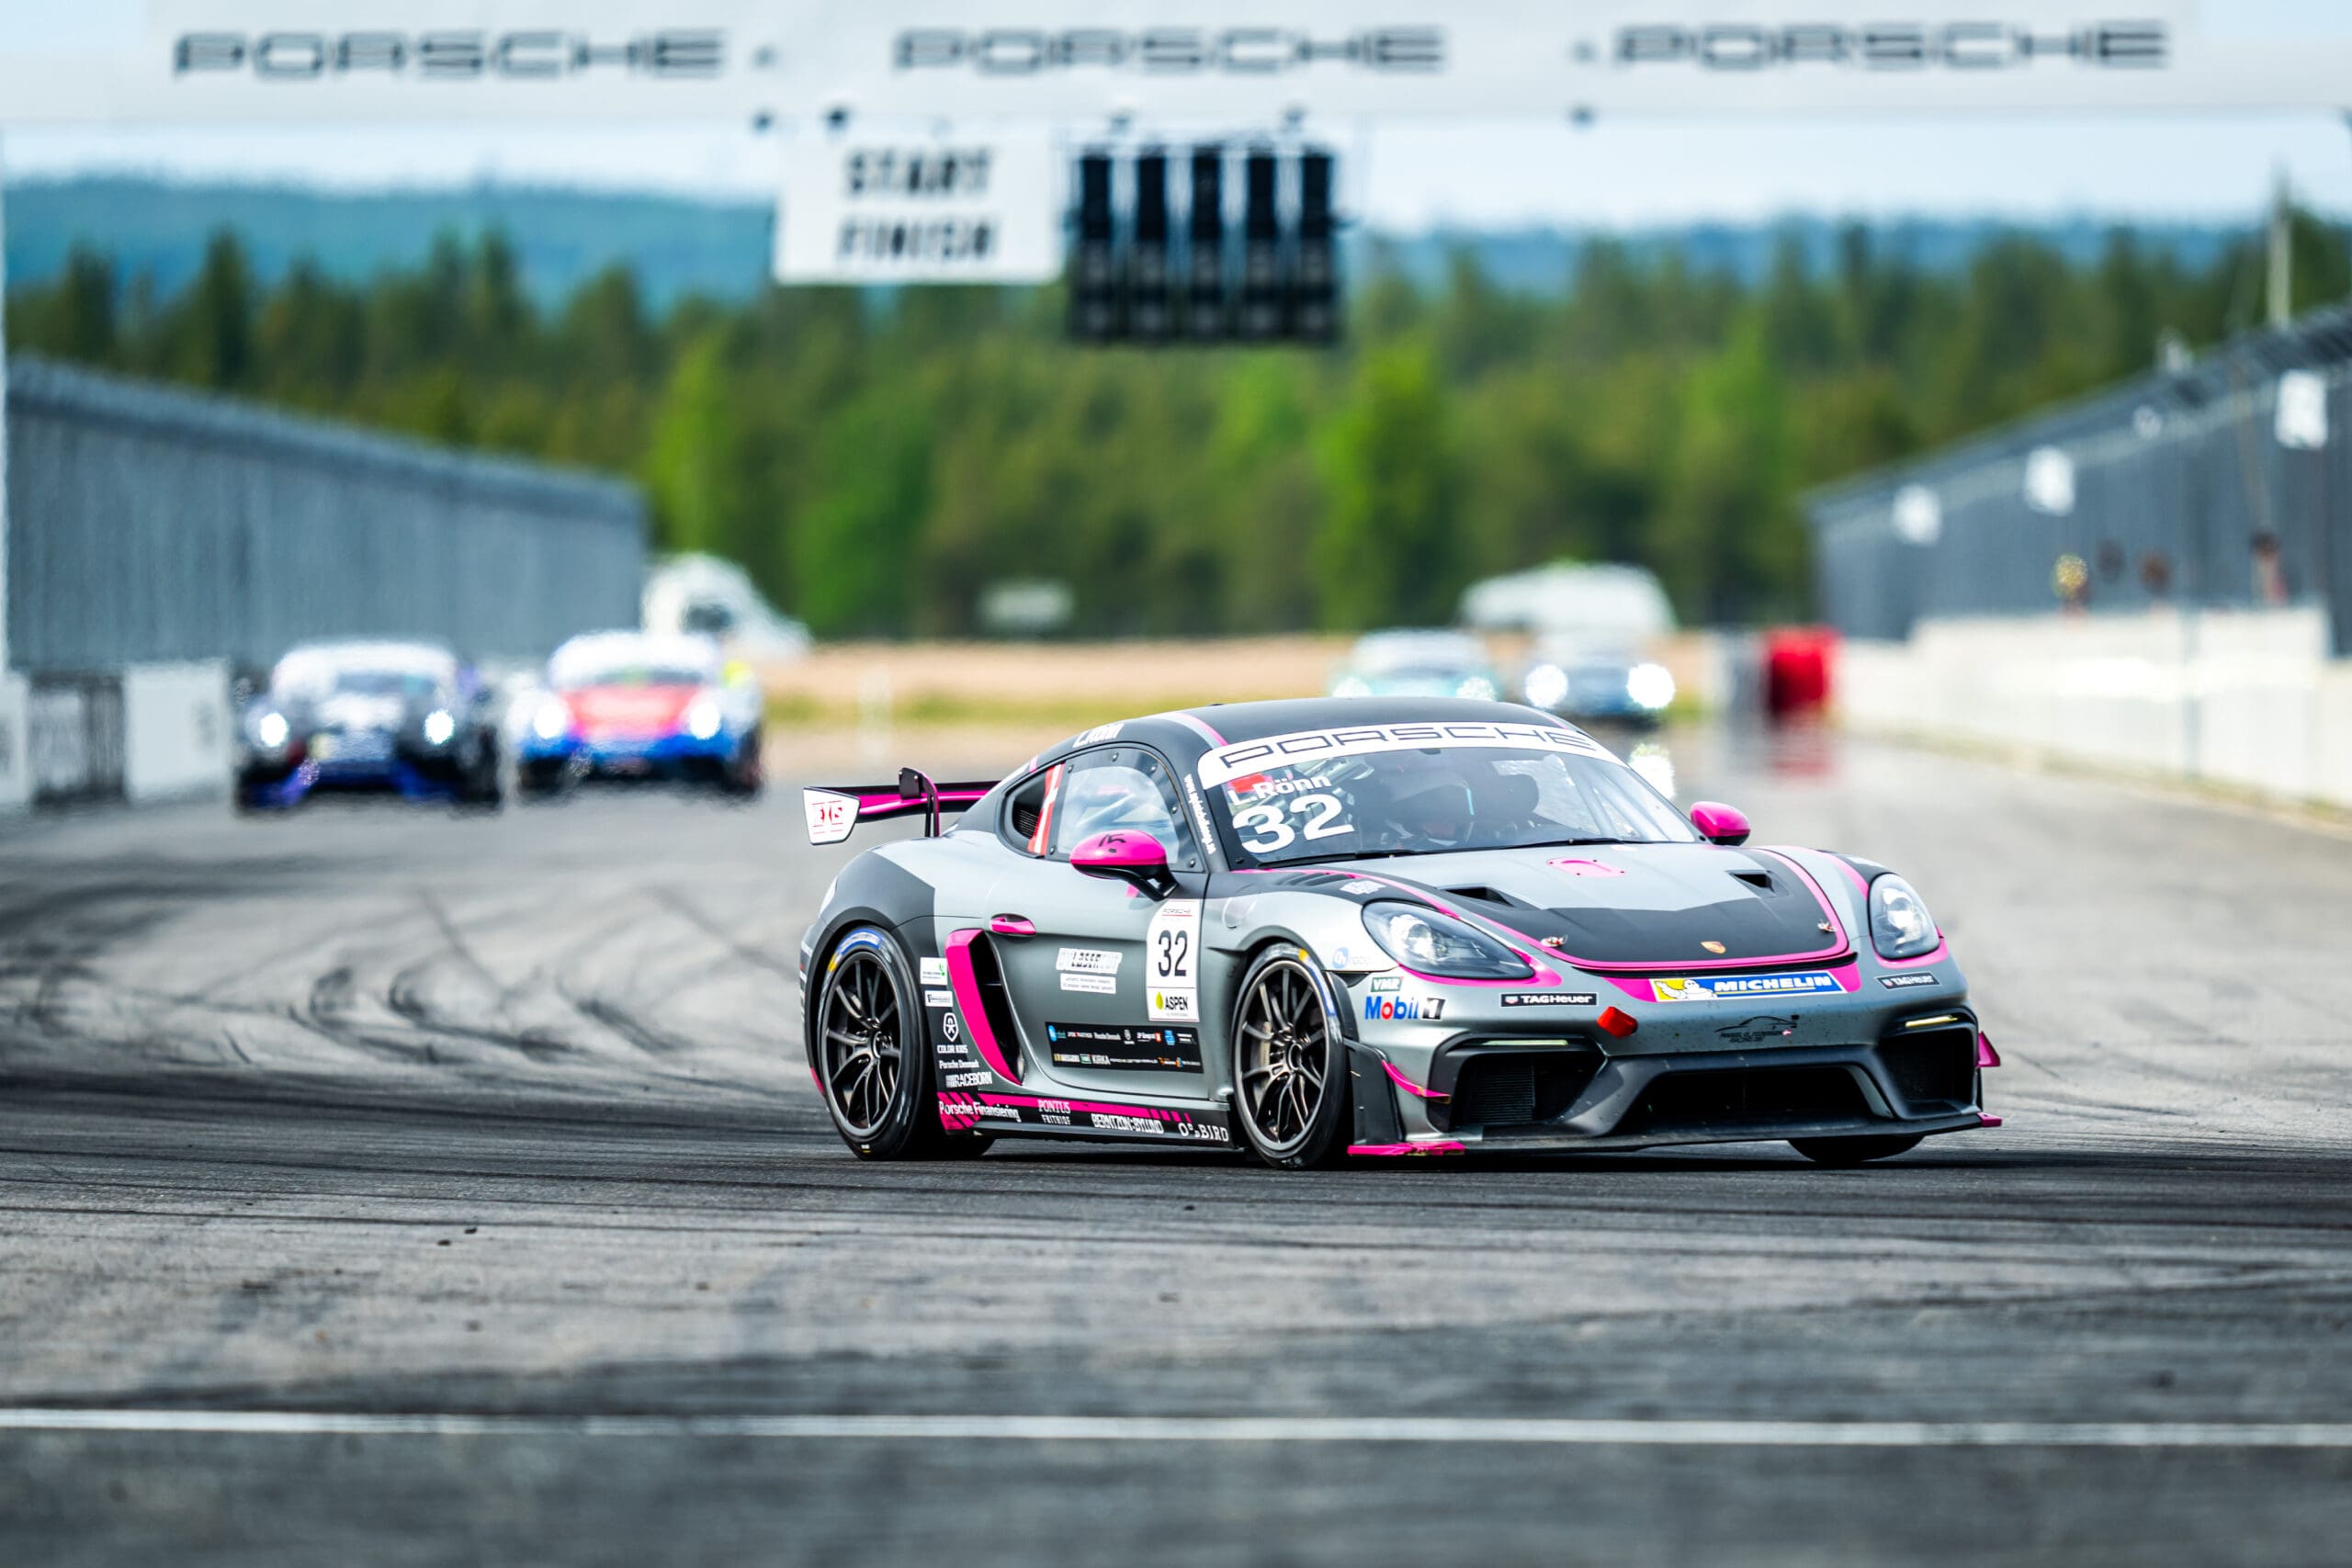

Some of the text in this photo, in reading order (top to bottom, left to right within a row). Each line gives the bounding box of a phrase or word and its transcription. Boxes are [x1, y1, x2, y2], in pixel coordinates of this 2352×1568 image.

[173, 29, 726, 80] PORSCHE
[894, 25, 1445, 75] PORSCHE
[1615, 18, 2170, 71] PORSCHE
[843, 146, 993, 197] START
[837, 215, 1000, 262] FINISH
[1220, 726, 1597, 772] PORSCHE
[1232, 794, 1355, 854] 32
[1158, 929, 1188, 977] 32
[1165, 996, 1189, 1011] ASPEN
[1713, 975, 1832, 993] MICHELIN
[1364, 996, 1419, 1020] Mobil
[939, 1100, 973, 1115] Porsche
[1037, 1099, 1071, 1114] PONTUS
